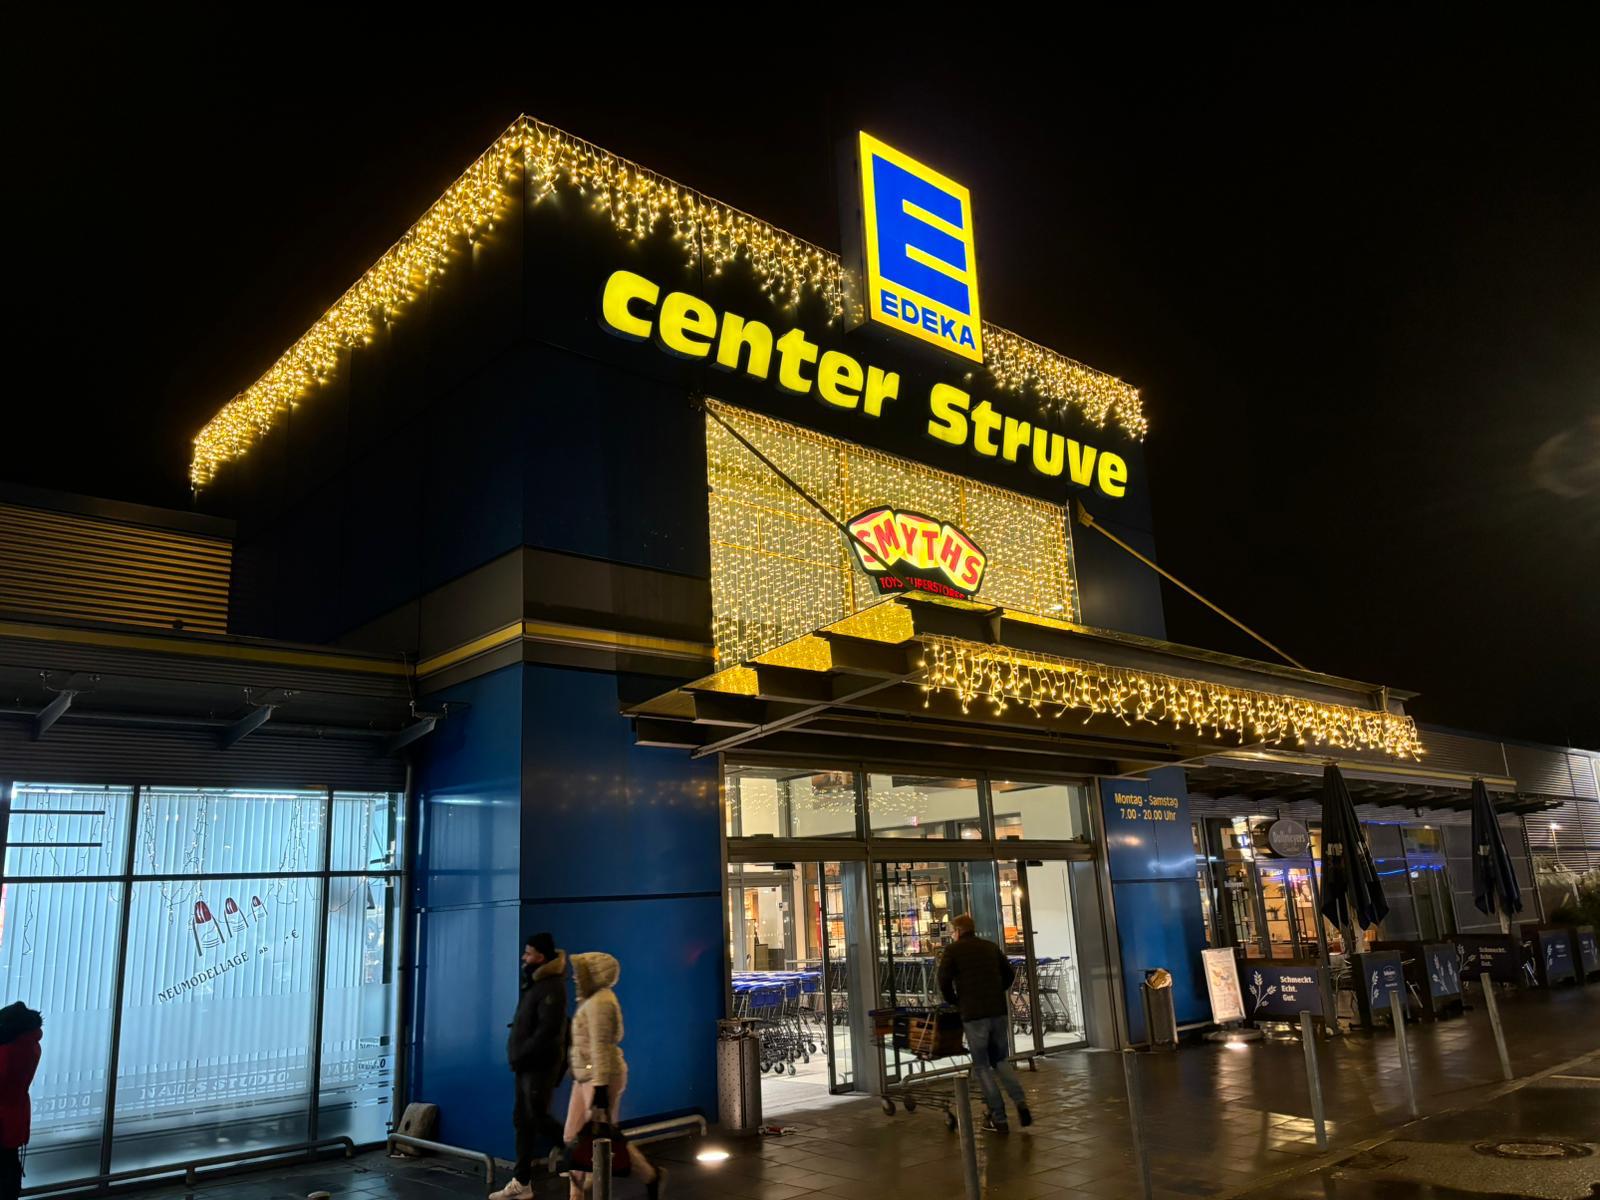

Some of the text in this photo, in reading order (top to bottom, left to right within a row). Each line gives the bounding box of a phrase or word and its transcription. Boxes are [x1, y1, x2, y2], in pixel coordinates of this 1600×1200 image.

[880, 288, 976, 350] EDEKA
[602, 270, 1128, 498] center Struve
[856, 518, 981, 585] SMYTHS
[879, 576, 904, 589] TOYS
[1114, 793, 1143, 806] Montag
[1148, 795, 1178, 808] Samstag
[1120, 808, 1137, 819] 7.00
[1143, 809, 1163, 820] 20.00
[1163, 810, 1176, 820] Uhr
[157, 951, 249, 1003] NEUMODELLAGE
[259, 946, 269, 954] ab
[1280, 976, 1314, 984] Schmeckt.
[212, 1071, 289, 1092] STUDIO
